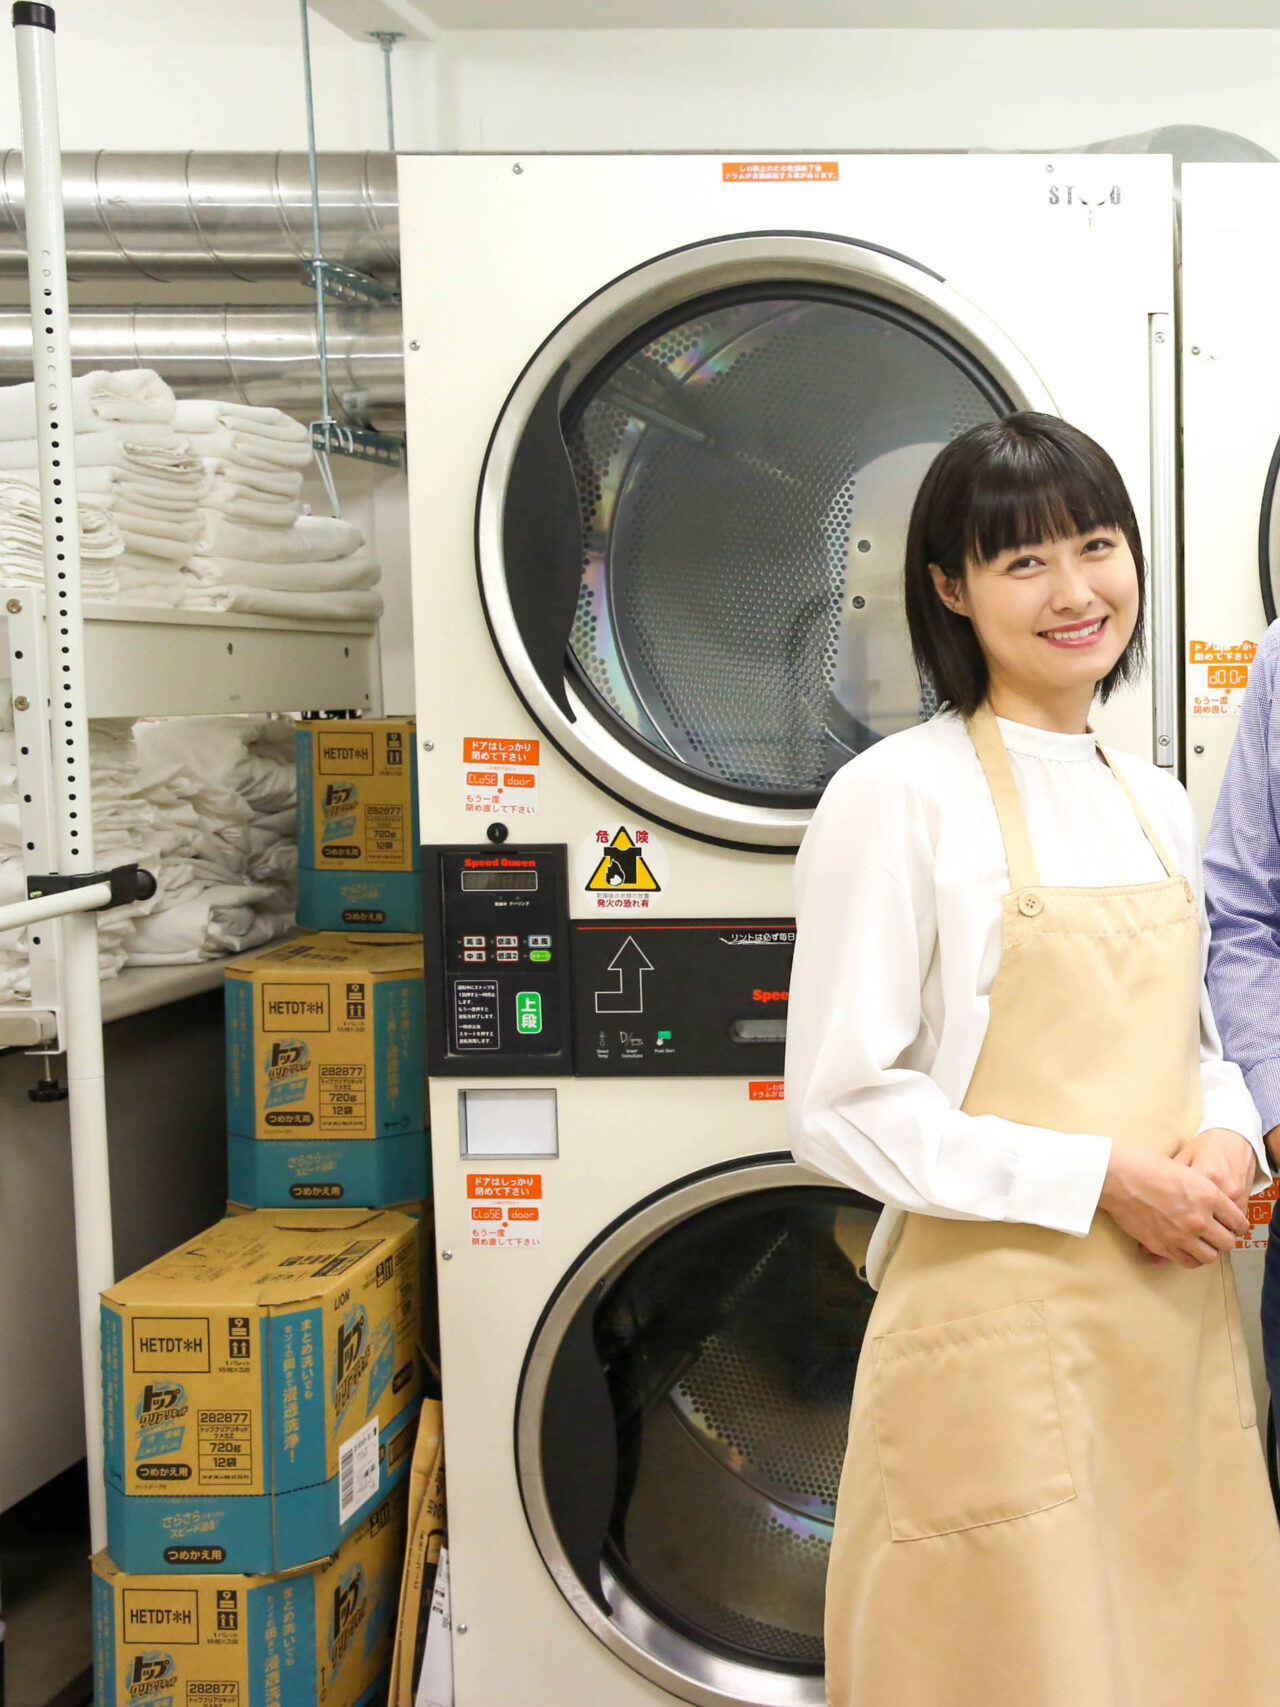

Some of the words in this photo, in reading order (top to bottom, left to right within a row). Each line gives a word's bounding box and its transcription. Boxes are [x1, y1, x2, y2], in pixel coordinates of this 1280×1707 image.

[1194, 696, 1228, 704] もう一度
[472, 740, 532, 752] ドアはしっかり
[472, 750, 527, 761] 閉めて下さい
[507, 776, 532, 786] door
[326, 784, 353, 806] トップ
[466, 794, 499, 803] もう一度
[367, 807, 400, 816] 282877
[466, 804, 535, 814] 閉め直して下さい
[374, 830, 396, 839] 720g
[596, 830, 609, 843] 危
[636, 830, 648, 844] 険
[324, 848, 359, 856] つめかえ用
[464, 858, 499, 868] Speed
[501, 858, 536, 866] Queen
[597, 899, 649, 908] 発火の恐れ有
[344, 912, 384, 922] つめかえ用
[732, 932, 795, 942] リントは必ず毎日
[521, 998, 537, 1028] 上段
[272, 1042, 304, 1066] トップ
[321, 1067, 363, 1076] 282877
[329, 1094, 356, 1102] 720g
[332, 1106, 352, 1115] 12袋
[268, 1114, 311, 1124] つめかえ用
[475, 1177, 534, 1186] ドアはしっかり
[292, 1187, 341, 1196] つめかえ用
[475, 1186, 530, 1196] 閉めて下さい
[472, 1228, 505, 1237] もう一度
[472, 1238, 540, 1246] 閉め直して下さい
[334, 1288, 350, 1310] LION
[336, 1314, 364, 1384] トップ
[144, 1385, 180, 1414] トップ
[200, 1413, 248, 1422] 282877
[210, 1443, 241, 1453] 720g
[213, 1458, 237, 1467] 12袋
[140, 1468, 188, 1478] つめかえ用
[168, 1550, 222, 1560] つめかえ用
[133, 1656, 170, 1684] トップ
[189, 1684, 236, 1694] 282877
